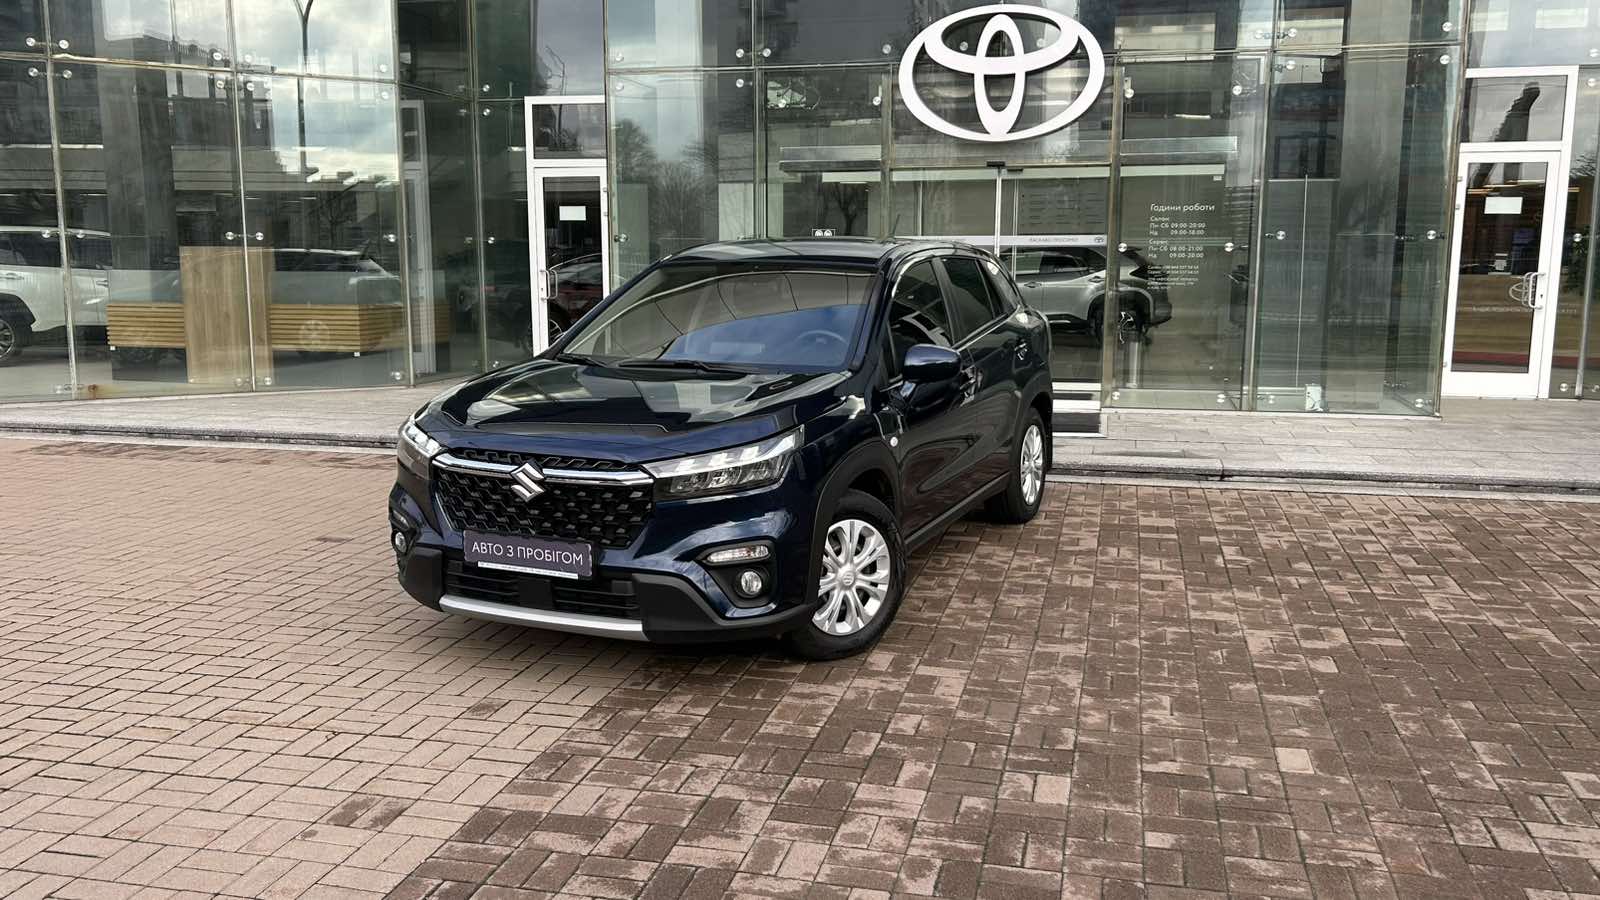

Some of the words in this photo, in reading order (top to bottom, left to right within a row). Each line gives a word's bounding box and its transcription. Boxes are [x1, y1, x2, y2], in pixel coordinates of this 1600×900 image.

[1151, 203, 1181, 212] Години
[1183, 203, 1215, 212] роботи
[471, 541, 504, 556] АВТО
[506, 545, 514, 557] З
[517, 546, 584, 565] ПРОБІГОМ
